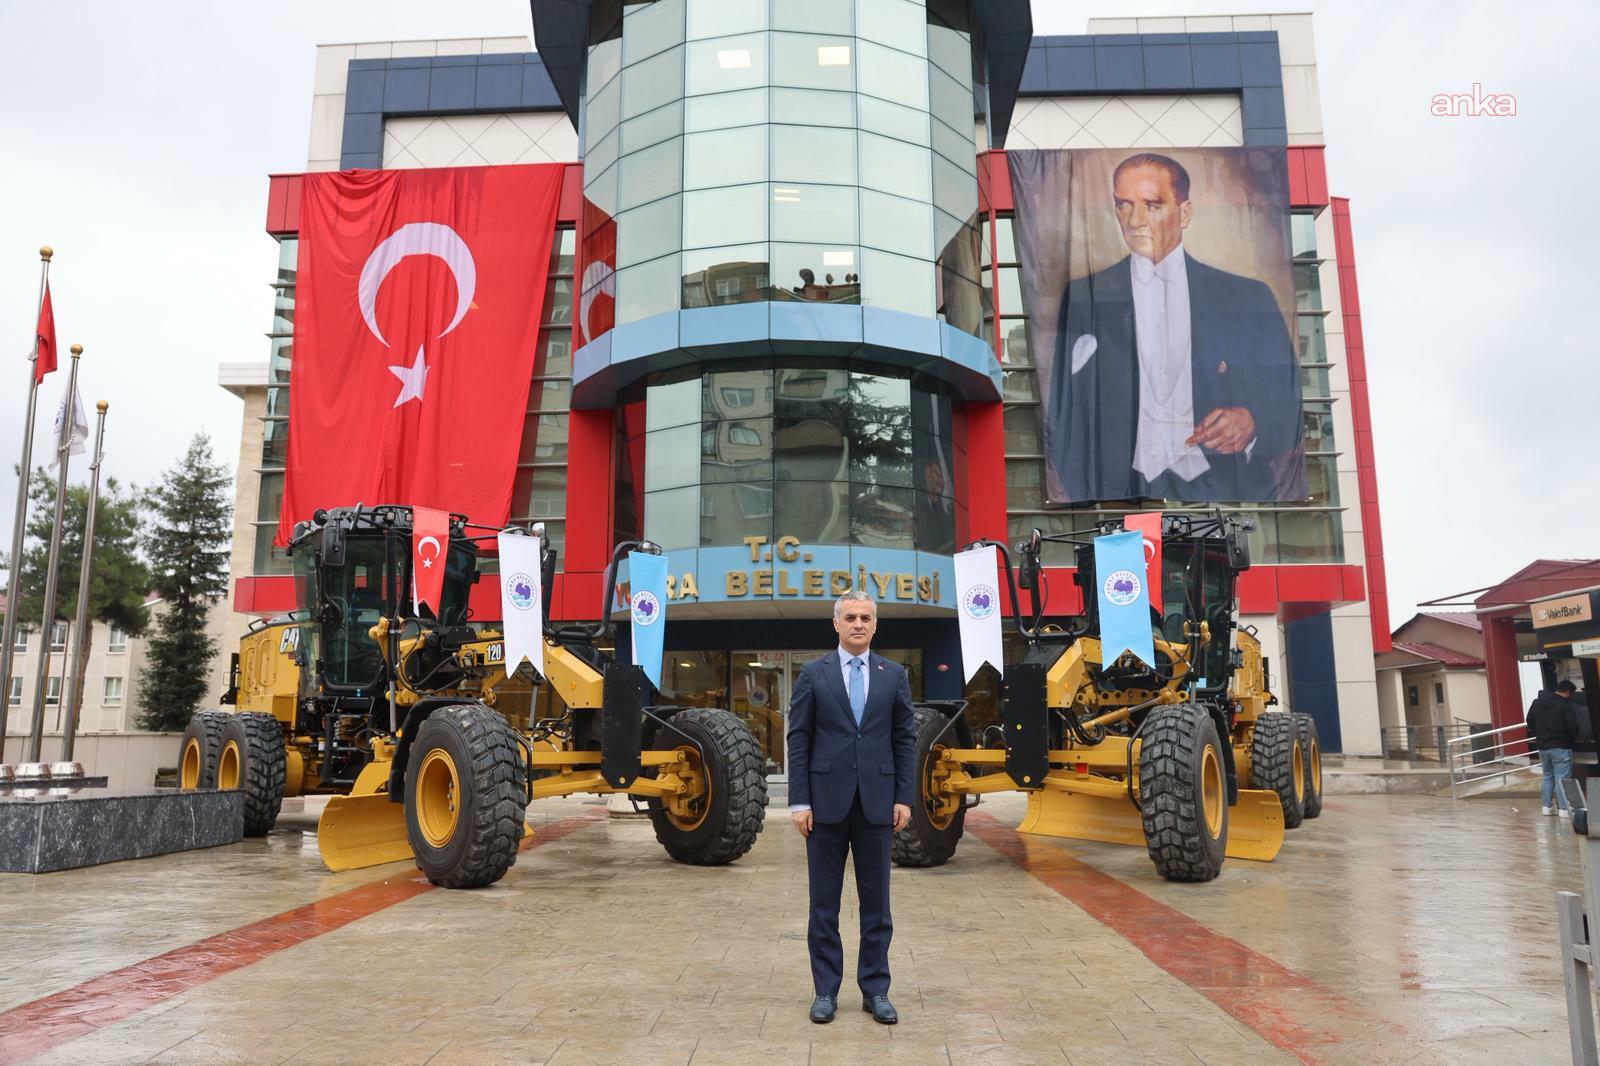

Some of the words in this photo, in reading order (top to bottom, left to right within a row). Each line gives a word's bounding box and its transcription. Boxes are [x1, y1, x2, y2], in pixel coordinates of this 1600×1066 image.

[744, 535, 813, 562] T.C.
[726, 564, 941, 602] BELEDİYESİ
[487, 643, 502, 661] 120
